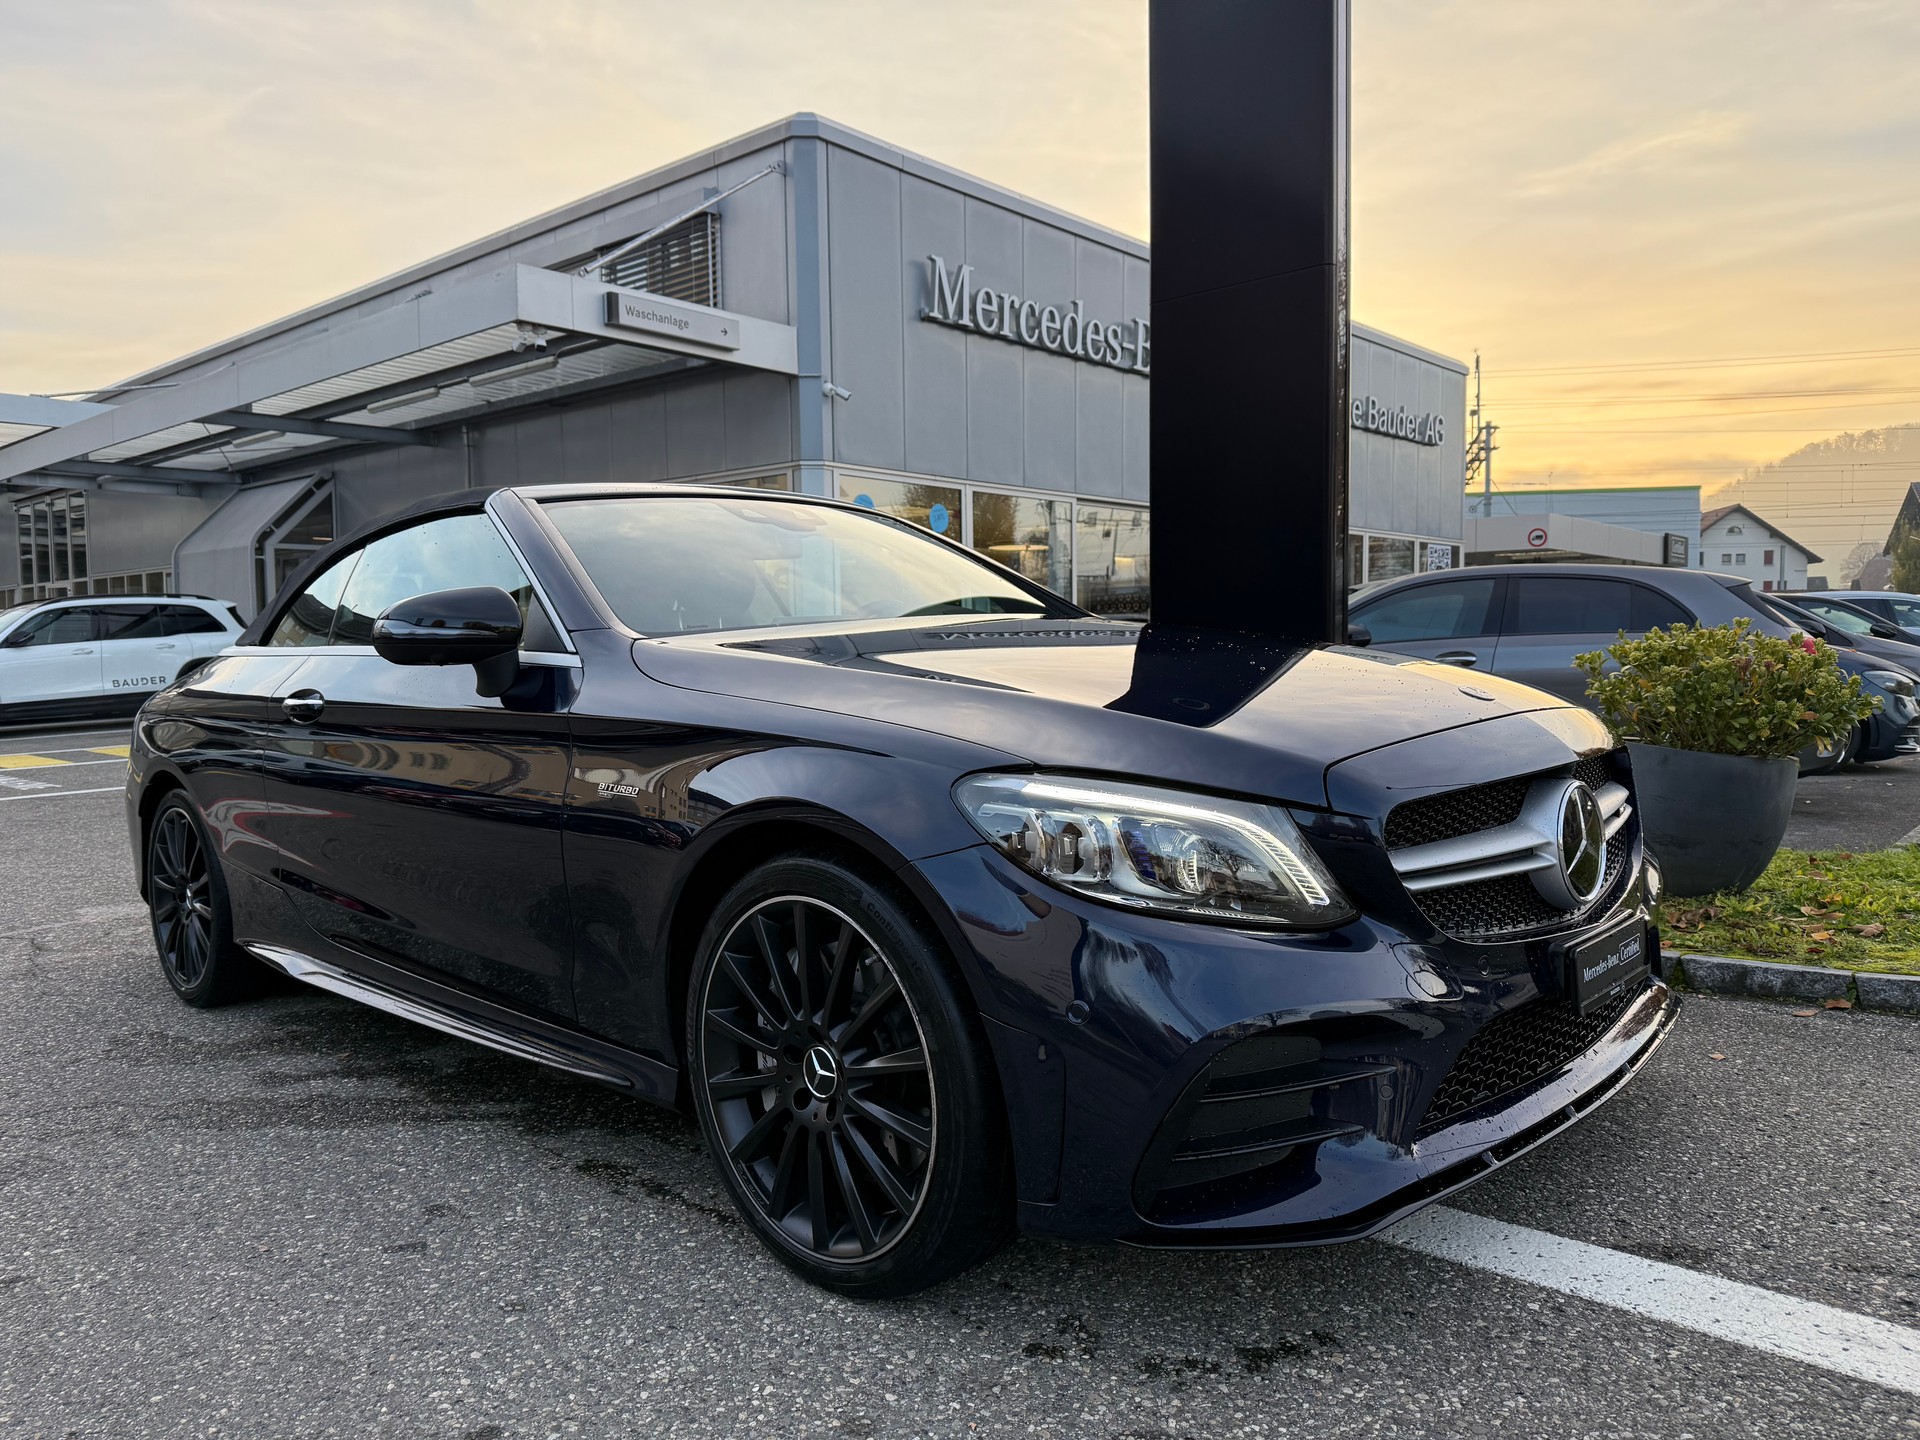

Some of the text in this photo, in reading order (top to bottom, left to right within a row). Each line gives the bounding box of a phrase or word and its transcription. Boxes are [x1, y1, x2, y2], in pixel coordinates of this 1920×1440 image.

[625, 304, 690, 330] Waschanlage
[1368, 396, 1422, 440] Bauder
[1425, 412, 1446, 445] AG
[112, 676, 167, 688] BAUDER
[598, 782, 640, 795] BITURBO
